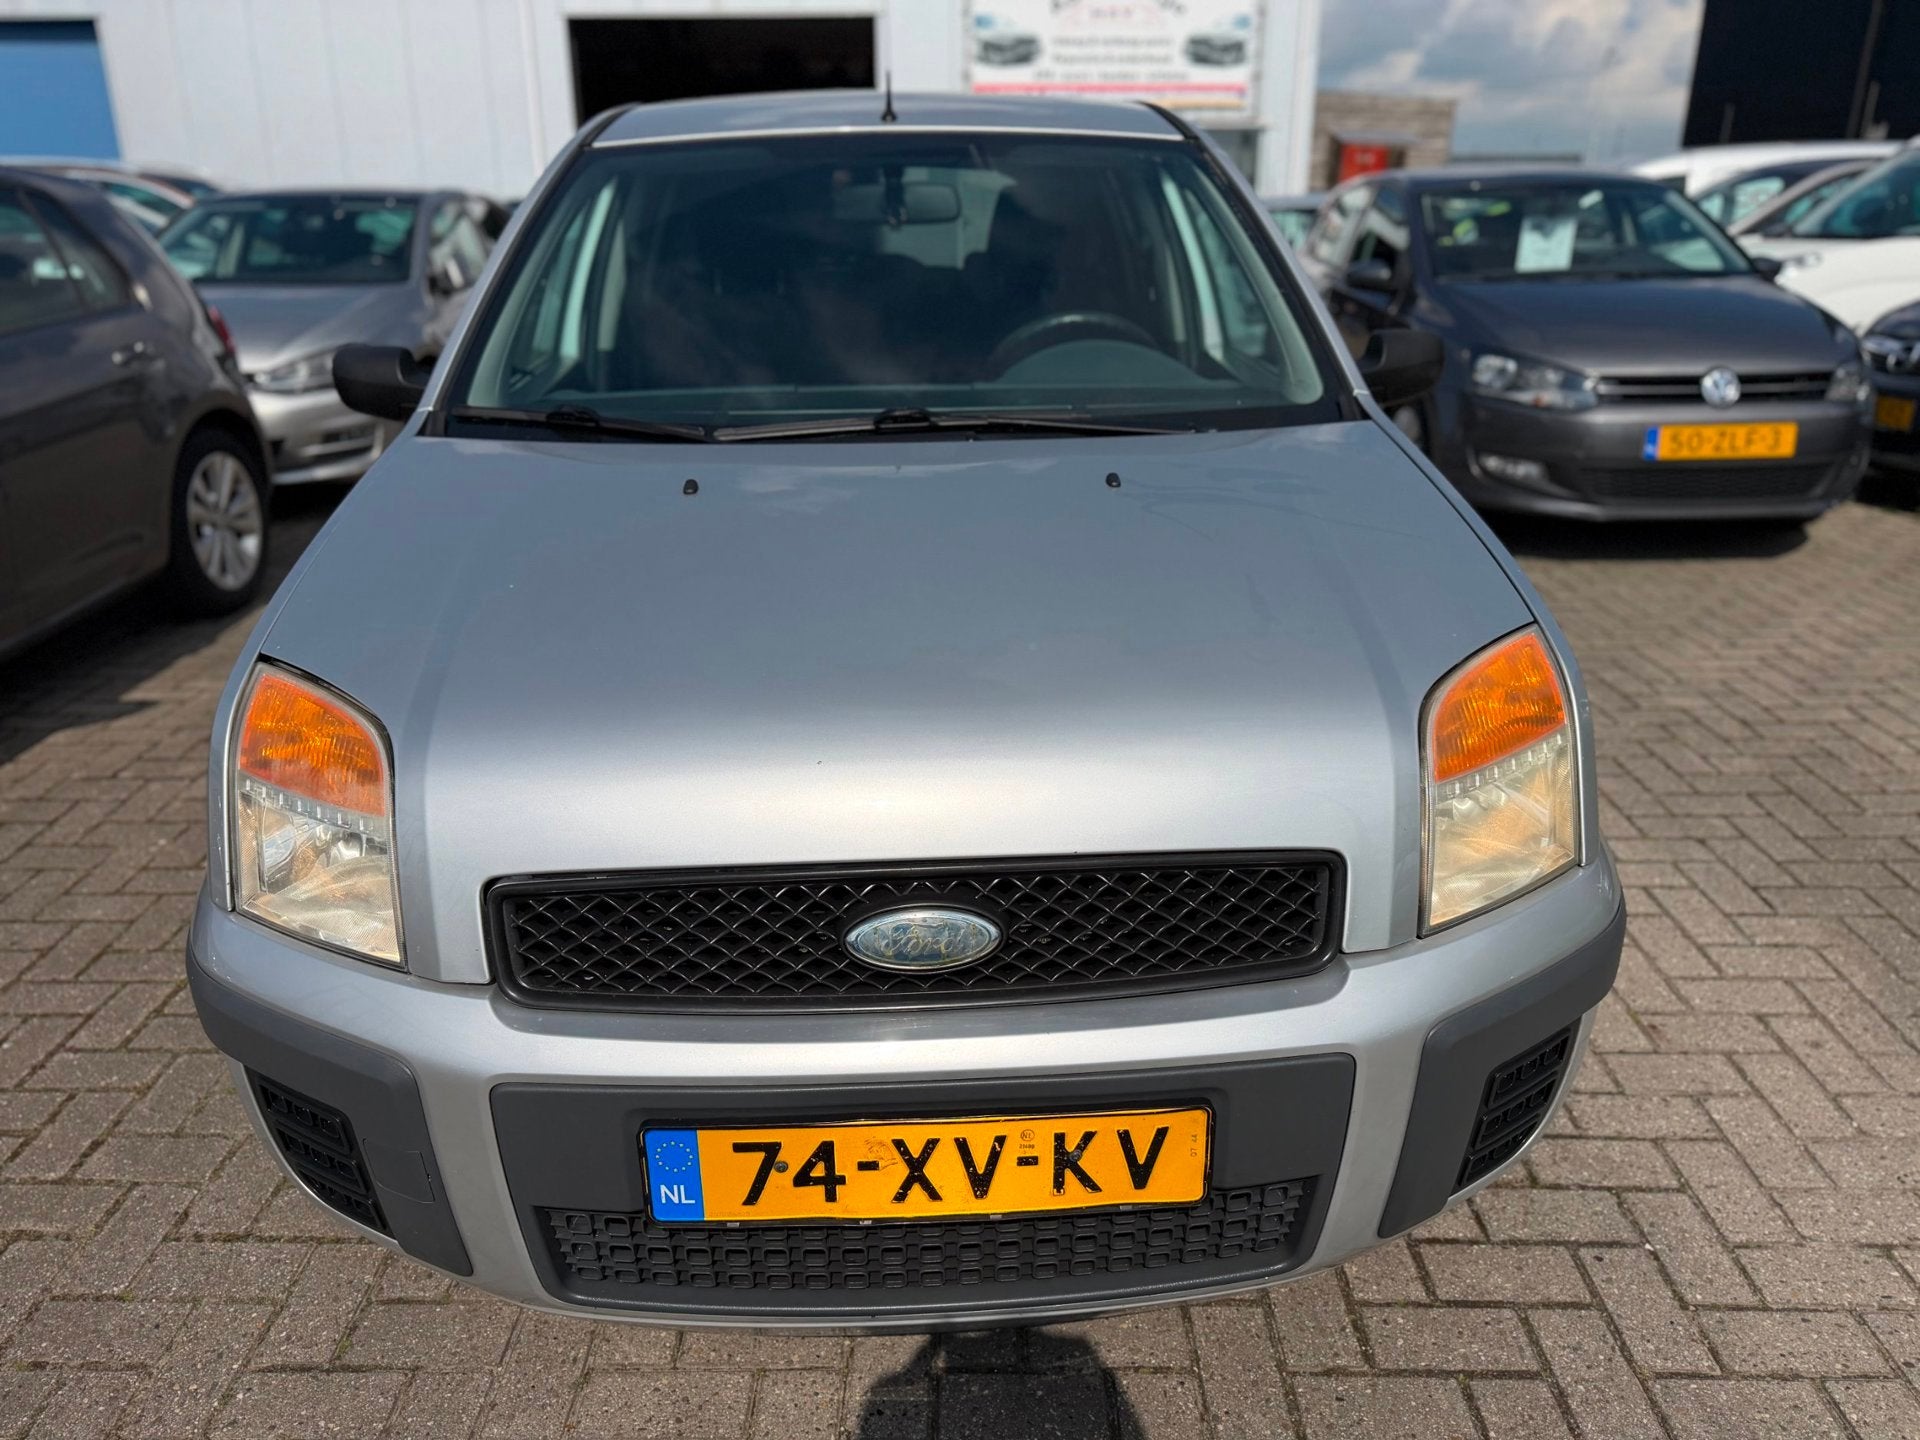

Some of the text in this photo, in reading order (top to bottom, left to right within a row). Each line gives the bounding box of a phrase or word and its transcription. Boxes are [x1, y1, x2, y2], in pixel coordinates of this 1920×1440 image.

[1669, 425, 1782, 454] 50-ZLF-3
[732, 1126, 1169, 1206] 74-XV-KV
[660, 1184, 696, 1204] NL
